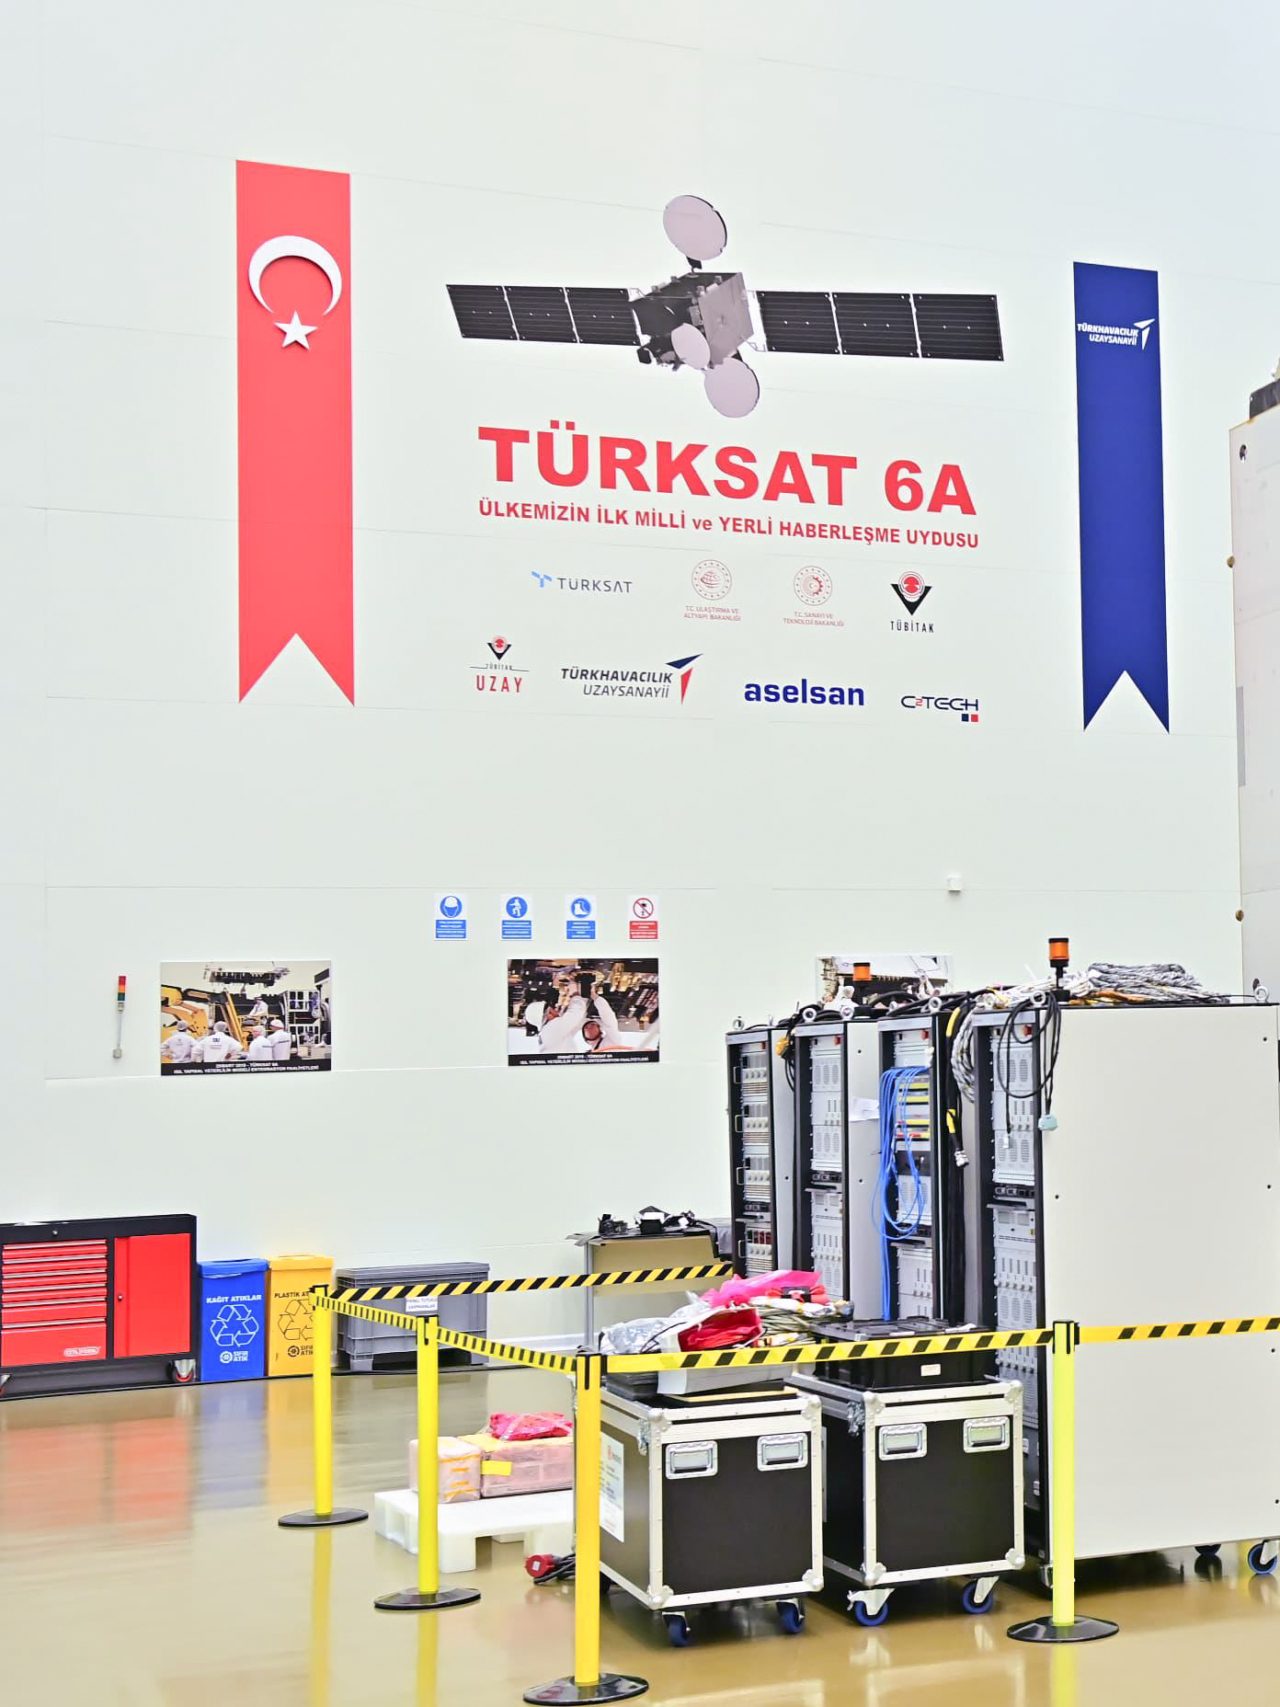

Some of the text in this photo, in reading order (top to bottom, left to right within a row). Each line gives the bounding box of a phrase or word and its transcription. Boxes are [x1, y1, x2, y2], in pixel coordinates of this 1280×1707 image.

[478, 420, 977, 515] TÜRKSAT 6A
[479, 497, 979, 548] ÜLKEMİZİN İLK MİLLİ ve YERLİ HABERLEŞME UYDUSU
[890, 620, 934, 633] TÜBİTAK
[476, 675, 522, 693] UZAY
[561, 666, 673, 683] TÜRKHAVACILIK
[744, 678, 864, 706] aselsan
